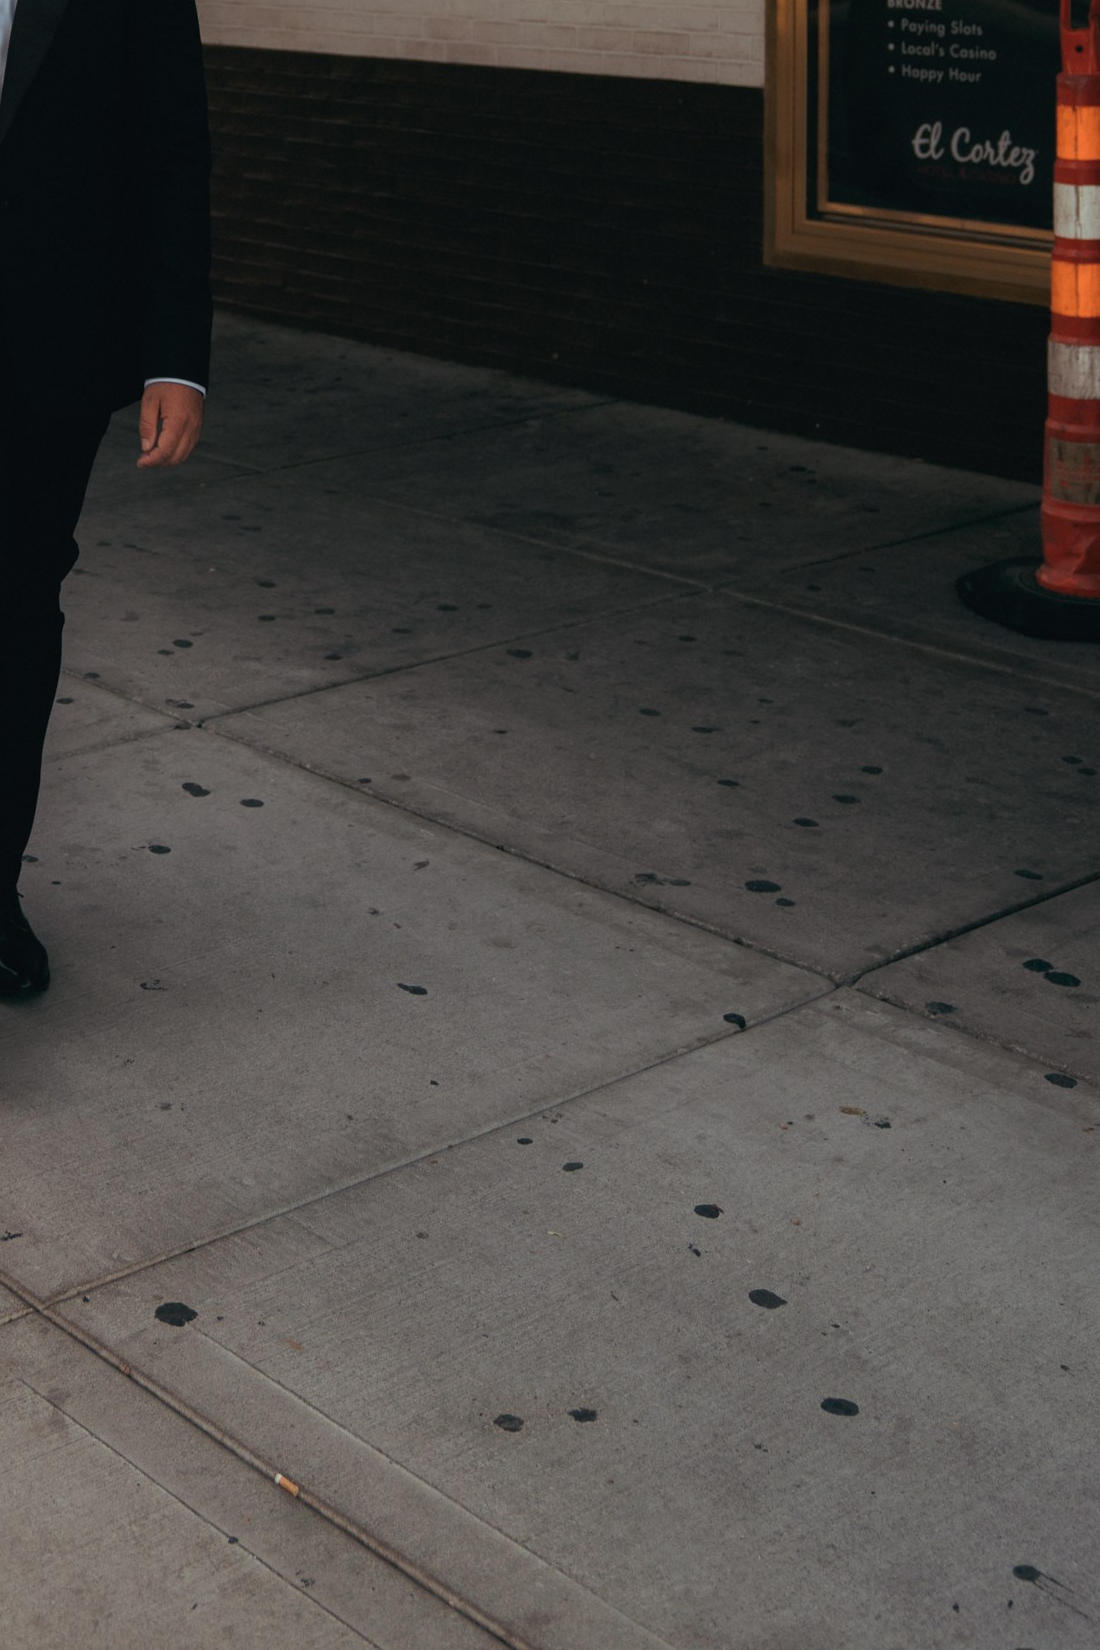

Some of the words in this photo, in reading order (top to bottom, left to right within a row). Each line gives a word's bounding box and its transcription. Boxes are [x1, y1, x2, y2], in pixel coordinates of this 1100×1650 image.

[901, 18, 946, 38] Paying
[950, 19, 983, 36] Slots
[901, 41, 945, 57] Local's
[949, 43, 997, 61] Casino
[901, 63, 944, 83] Happy
[948, 67, 982, 82] Hour
[911, 120, 945, 160] El
[950, 126, 1037, 186] Cortez
